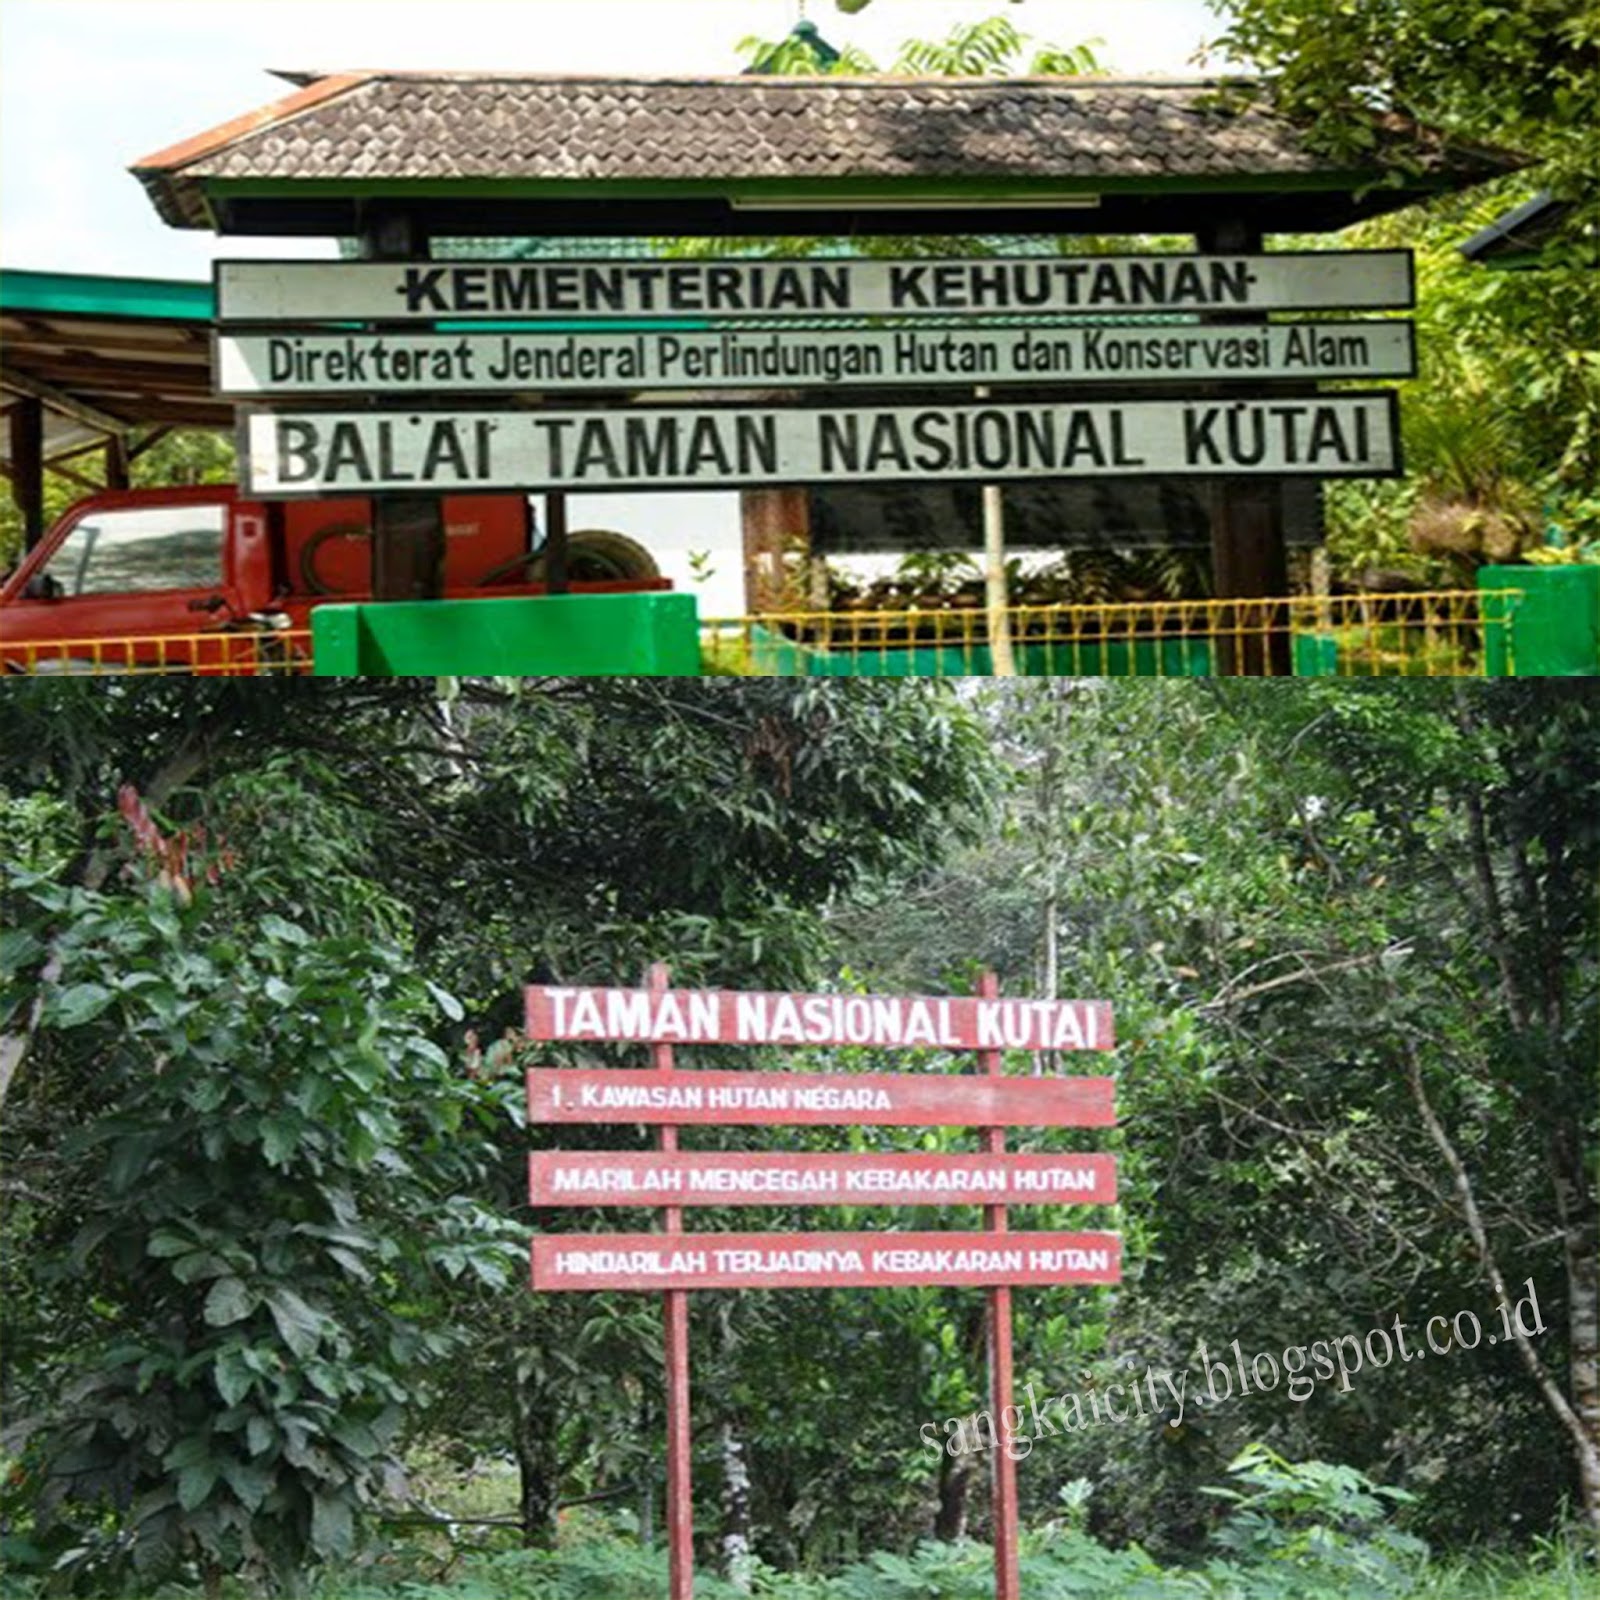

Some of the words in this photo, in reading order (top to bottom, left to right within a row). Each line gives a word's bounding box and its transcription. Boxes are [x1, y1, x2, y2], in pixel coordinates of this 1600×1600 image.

[405, 265, 849, 311] KEMENTERIAN
[889, 261, 1249, 309] KEHUTANAN
[270, 340, 475, 383] Direktorat
[489, 336, 645, 379] Jenderal
[658, 335, 882, 383] Perlindungan
[893, 333, 998, 376] Hutan
[1012, 329, 1072, 372] dan
[1084, 326, 1271, 372] Konservasi
[1283, 323, 1368, 368] Alam
[276, 418, 497, 483] BALAI
[533, 415, 778, 480] TAMAN
[818, 408, 1145, 473] NASIONAL
[1183, 404, 1370, 464] KUTAI
[545, 988, 720, 1040] TAMAN
[736, 995, 963, 1046] NASIONAL
[976, 1000, 1099, 1049] KUTAI
[581, 1085, 702, 1108] KAWASAN
[708, 1086, 787, 1109] HUTAN
[793, 1088, 892, 1111] NEGARA
[552, 1168, 681, 1192] MARILAH
[689, 1168, 838, 1191] MENCEGAH
[845, 1168, 1007, 1191] KEBAKARAN
[1013, 1168, 1096, 1192] HUTAN
[556, 1250, 706, 1274] HINDARILAH
[713, 1249, 864, 1274] TERJADINYA
[872, 1250, 1023, 1273] KEBAKARAN
[1029, 1250, 1108, 1272] HUTAN
